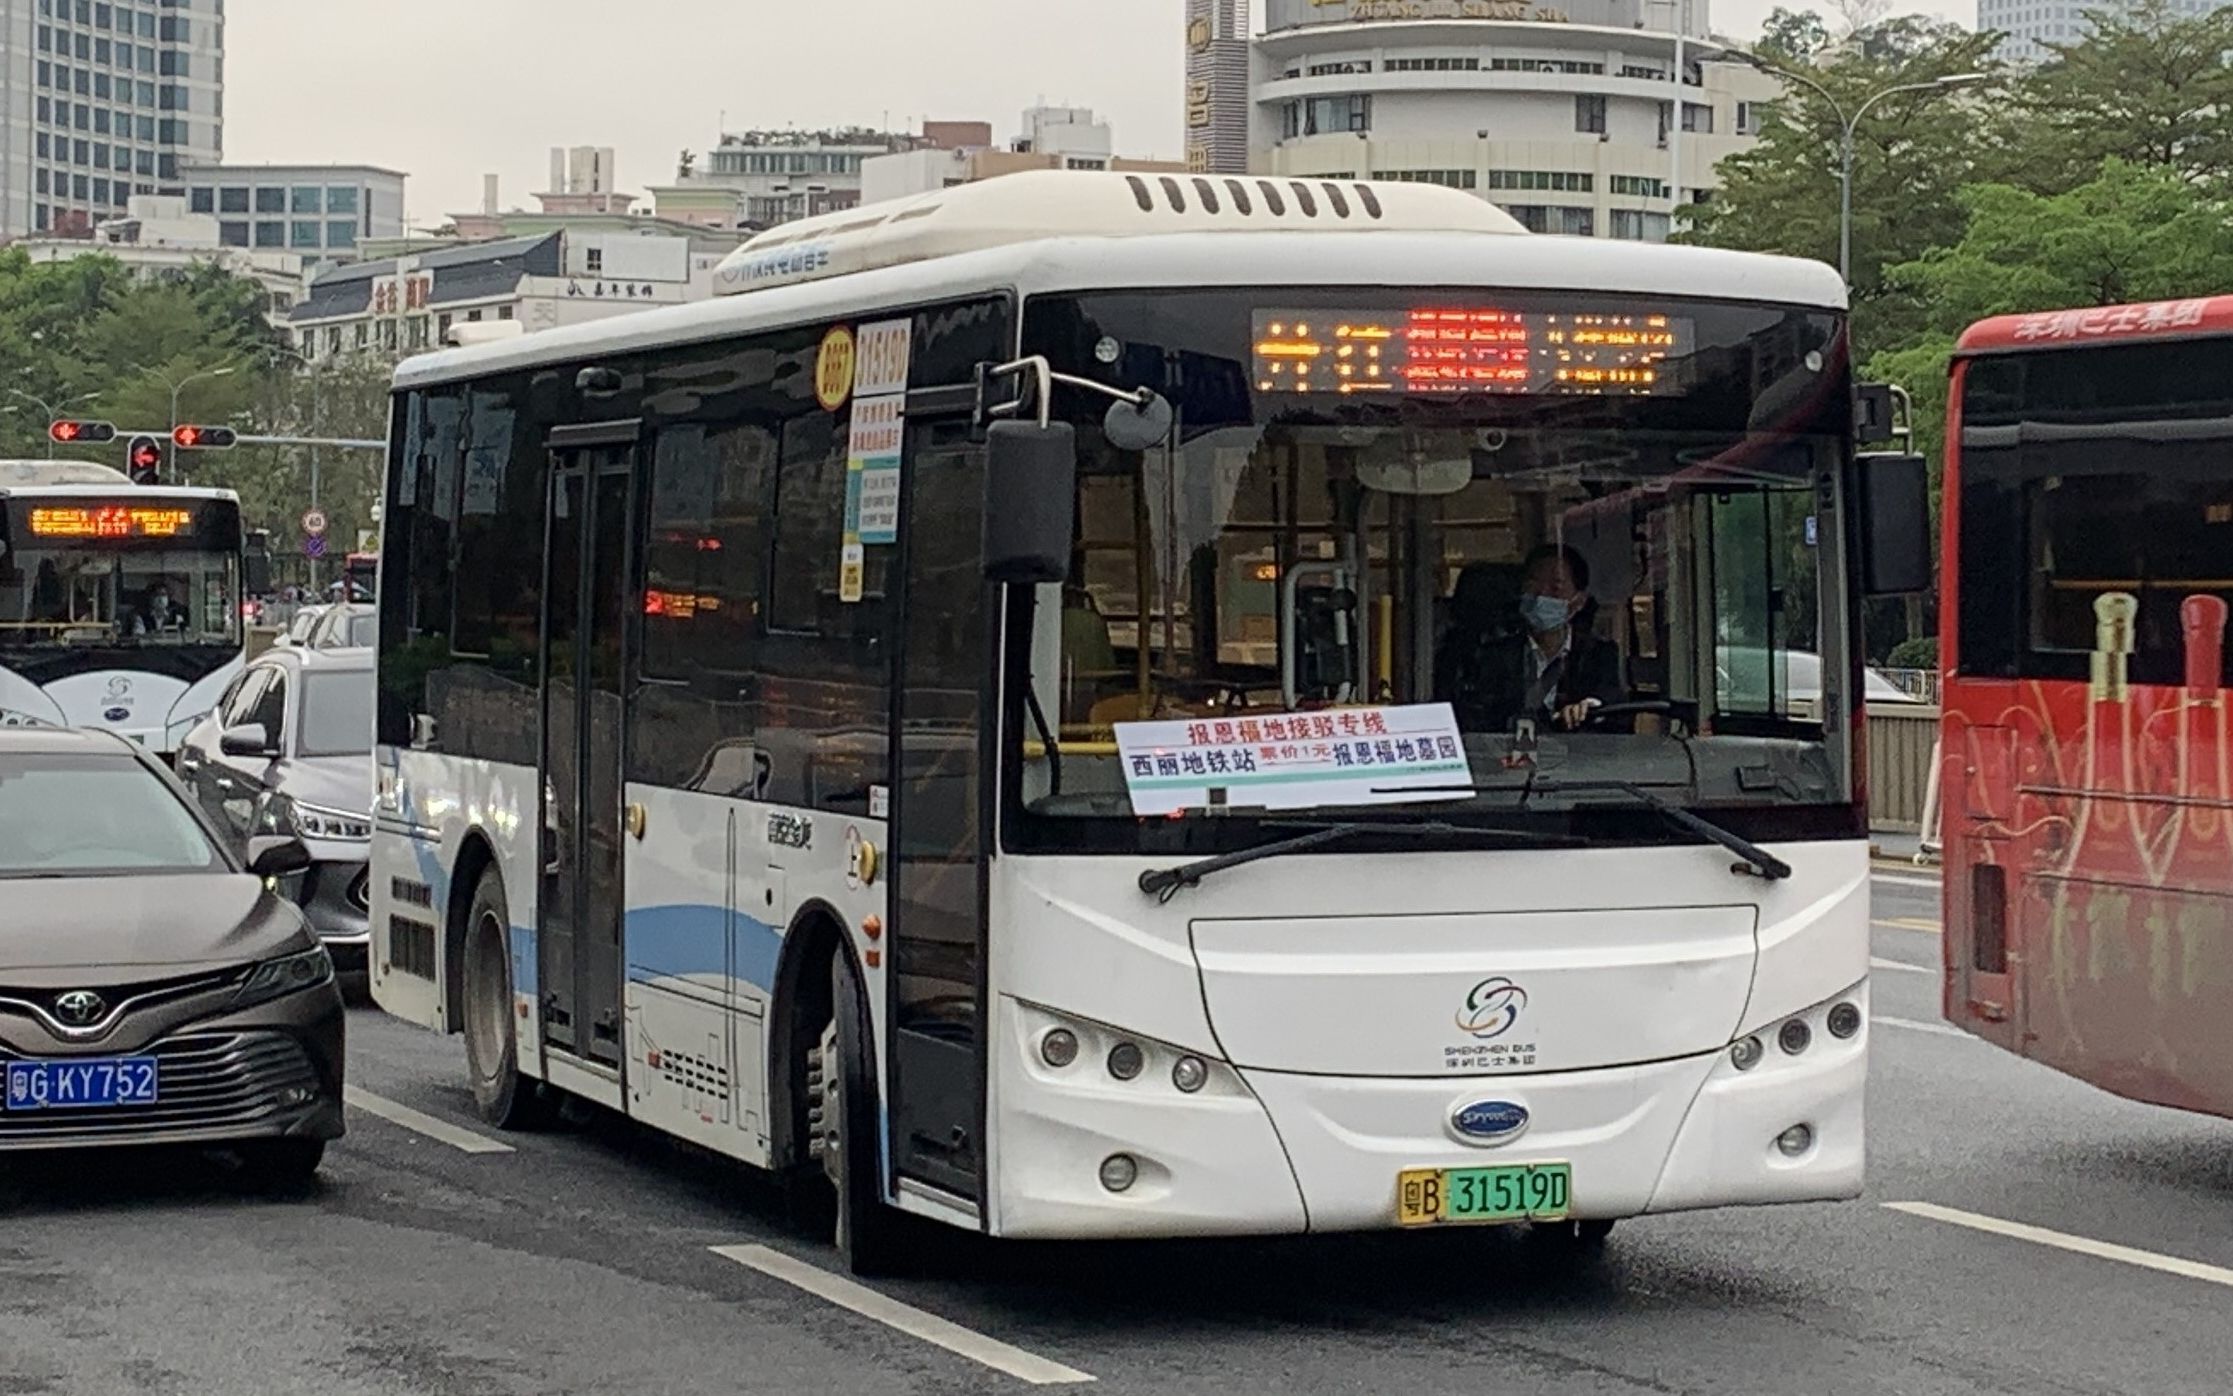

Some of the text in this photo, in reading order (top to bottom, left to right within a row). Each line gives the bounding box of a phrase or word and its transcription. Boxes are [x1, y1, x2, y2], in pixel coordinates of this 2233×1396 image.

[1187, 711, 1388, 746] 报恩福地接驳专线
[1128, 735, 1459, 777] 西丽地铁站 票价1元 报恩福地墓园
